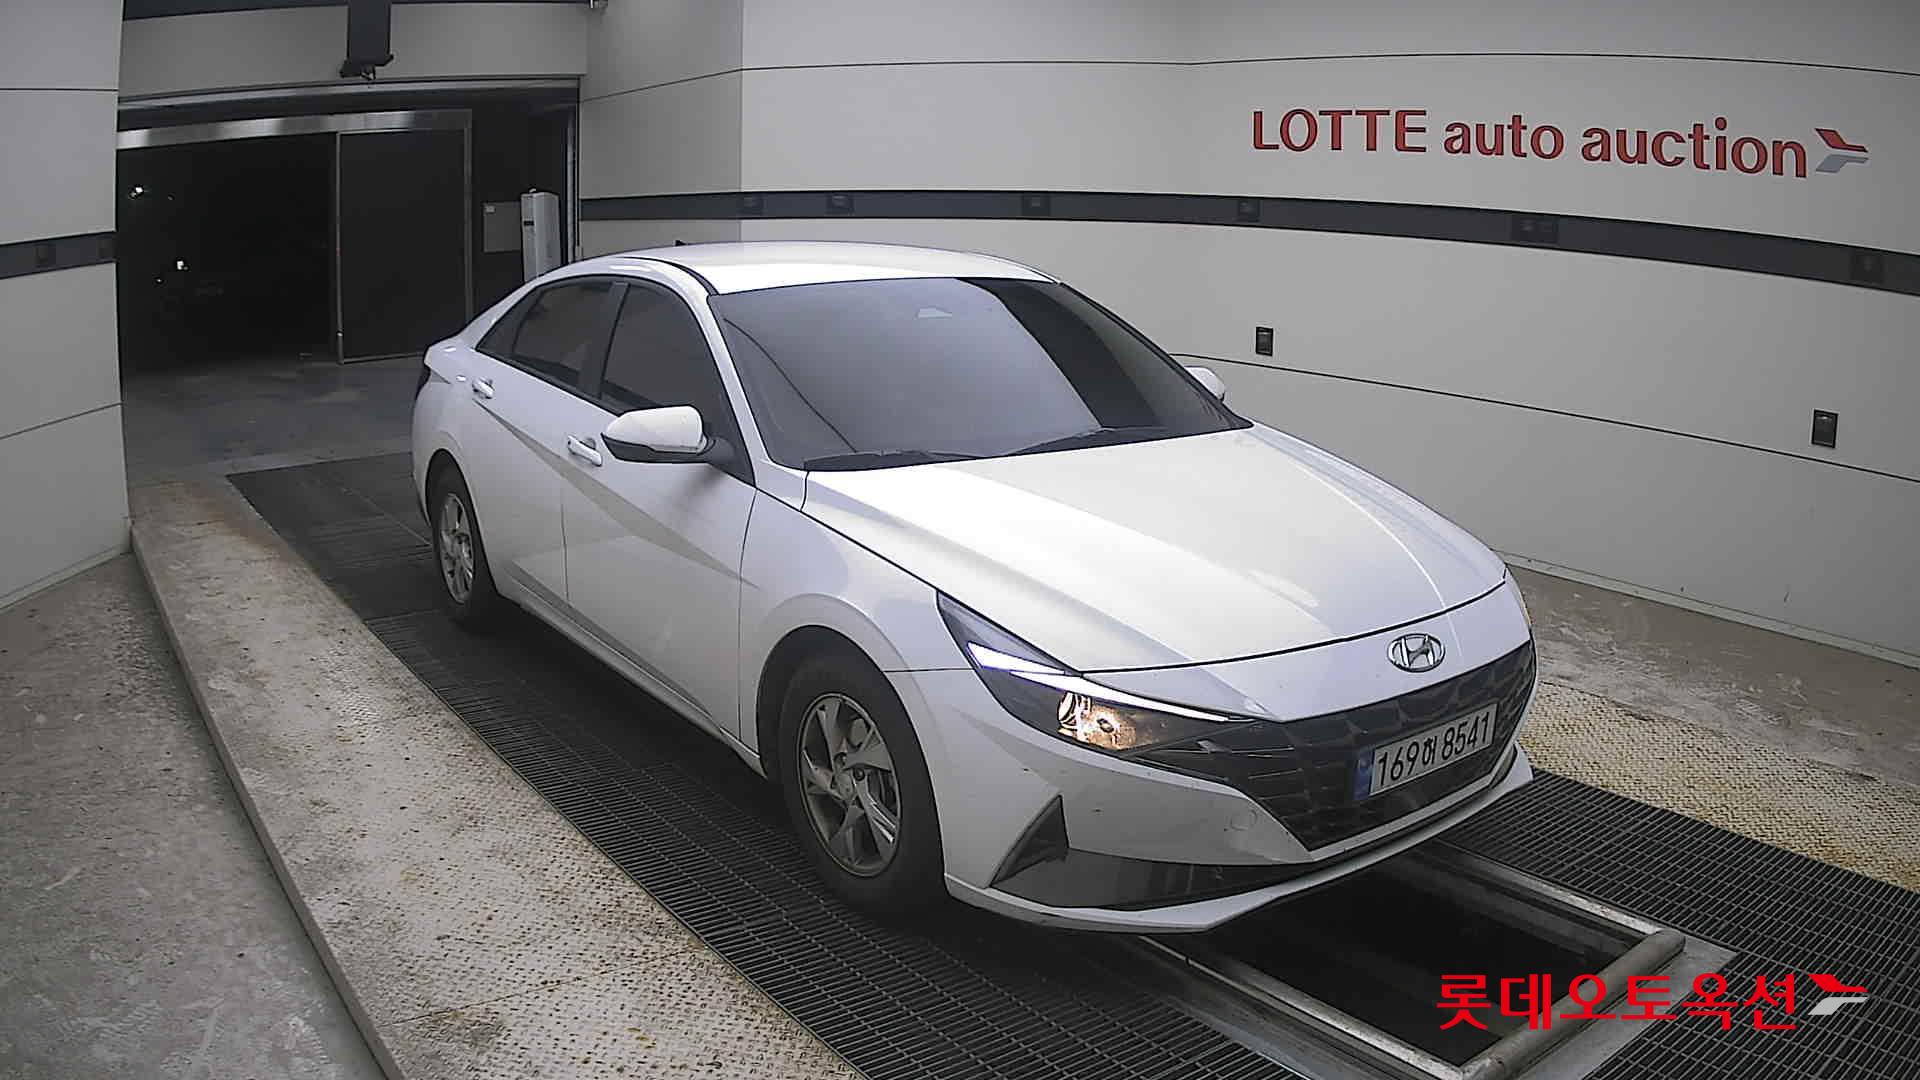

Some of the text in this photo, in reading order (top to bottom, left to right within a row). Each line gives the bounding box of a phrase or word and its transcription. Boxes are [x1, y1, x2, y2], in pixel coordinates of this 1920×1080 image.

[1252, 109, 1808, 179] LOTTE auto auction
[1441, 711, 1490, 761] 8541
